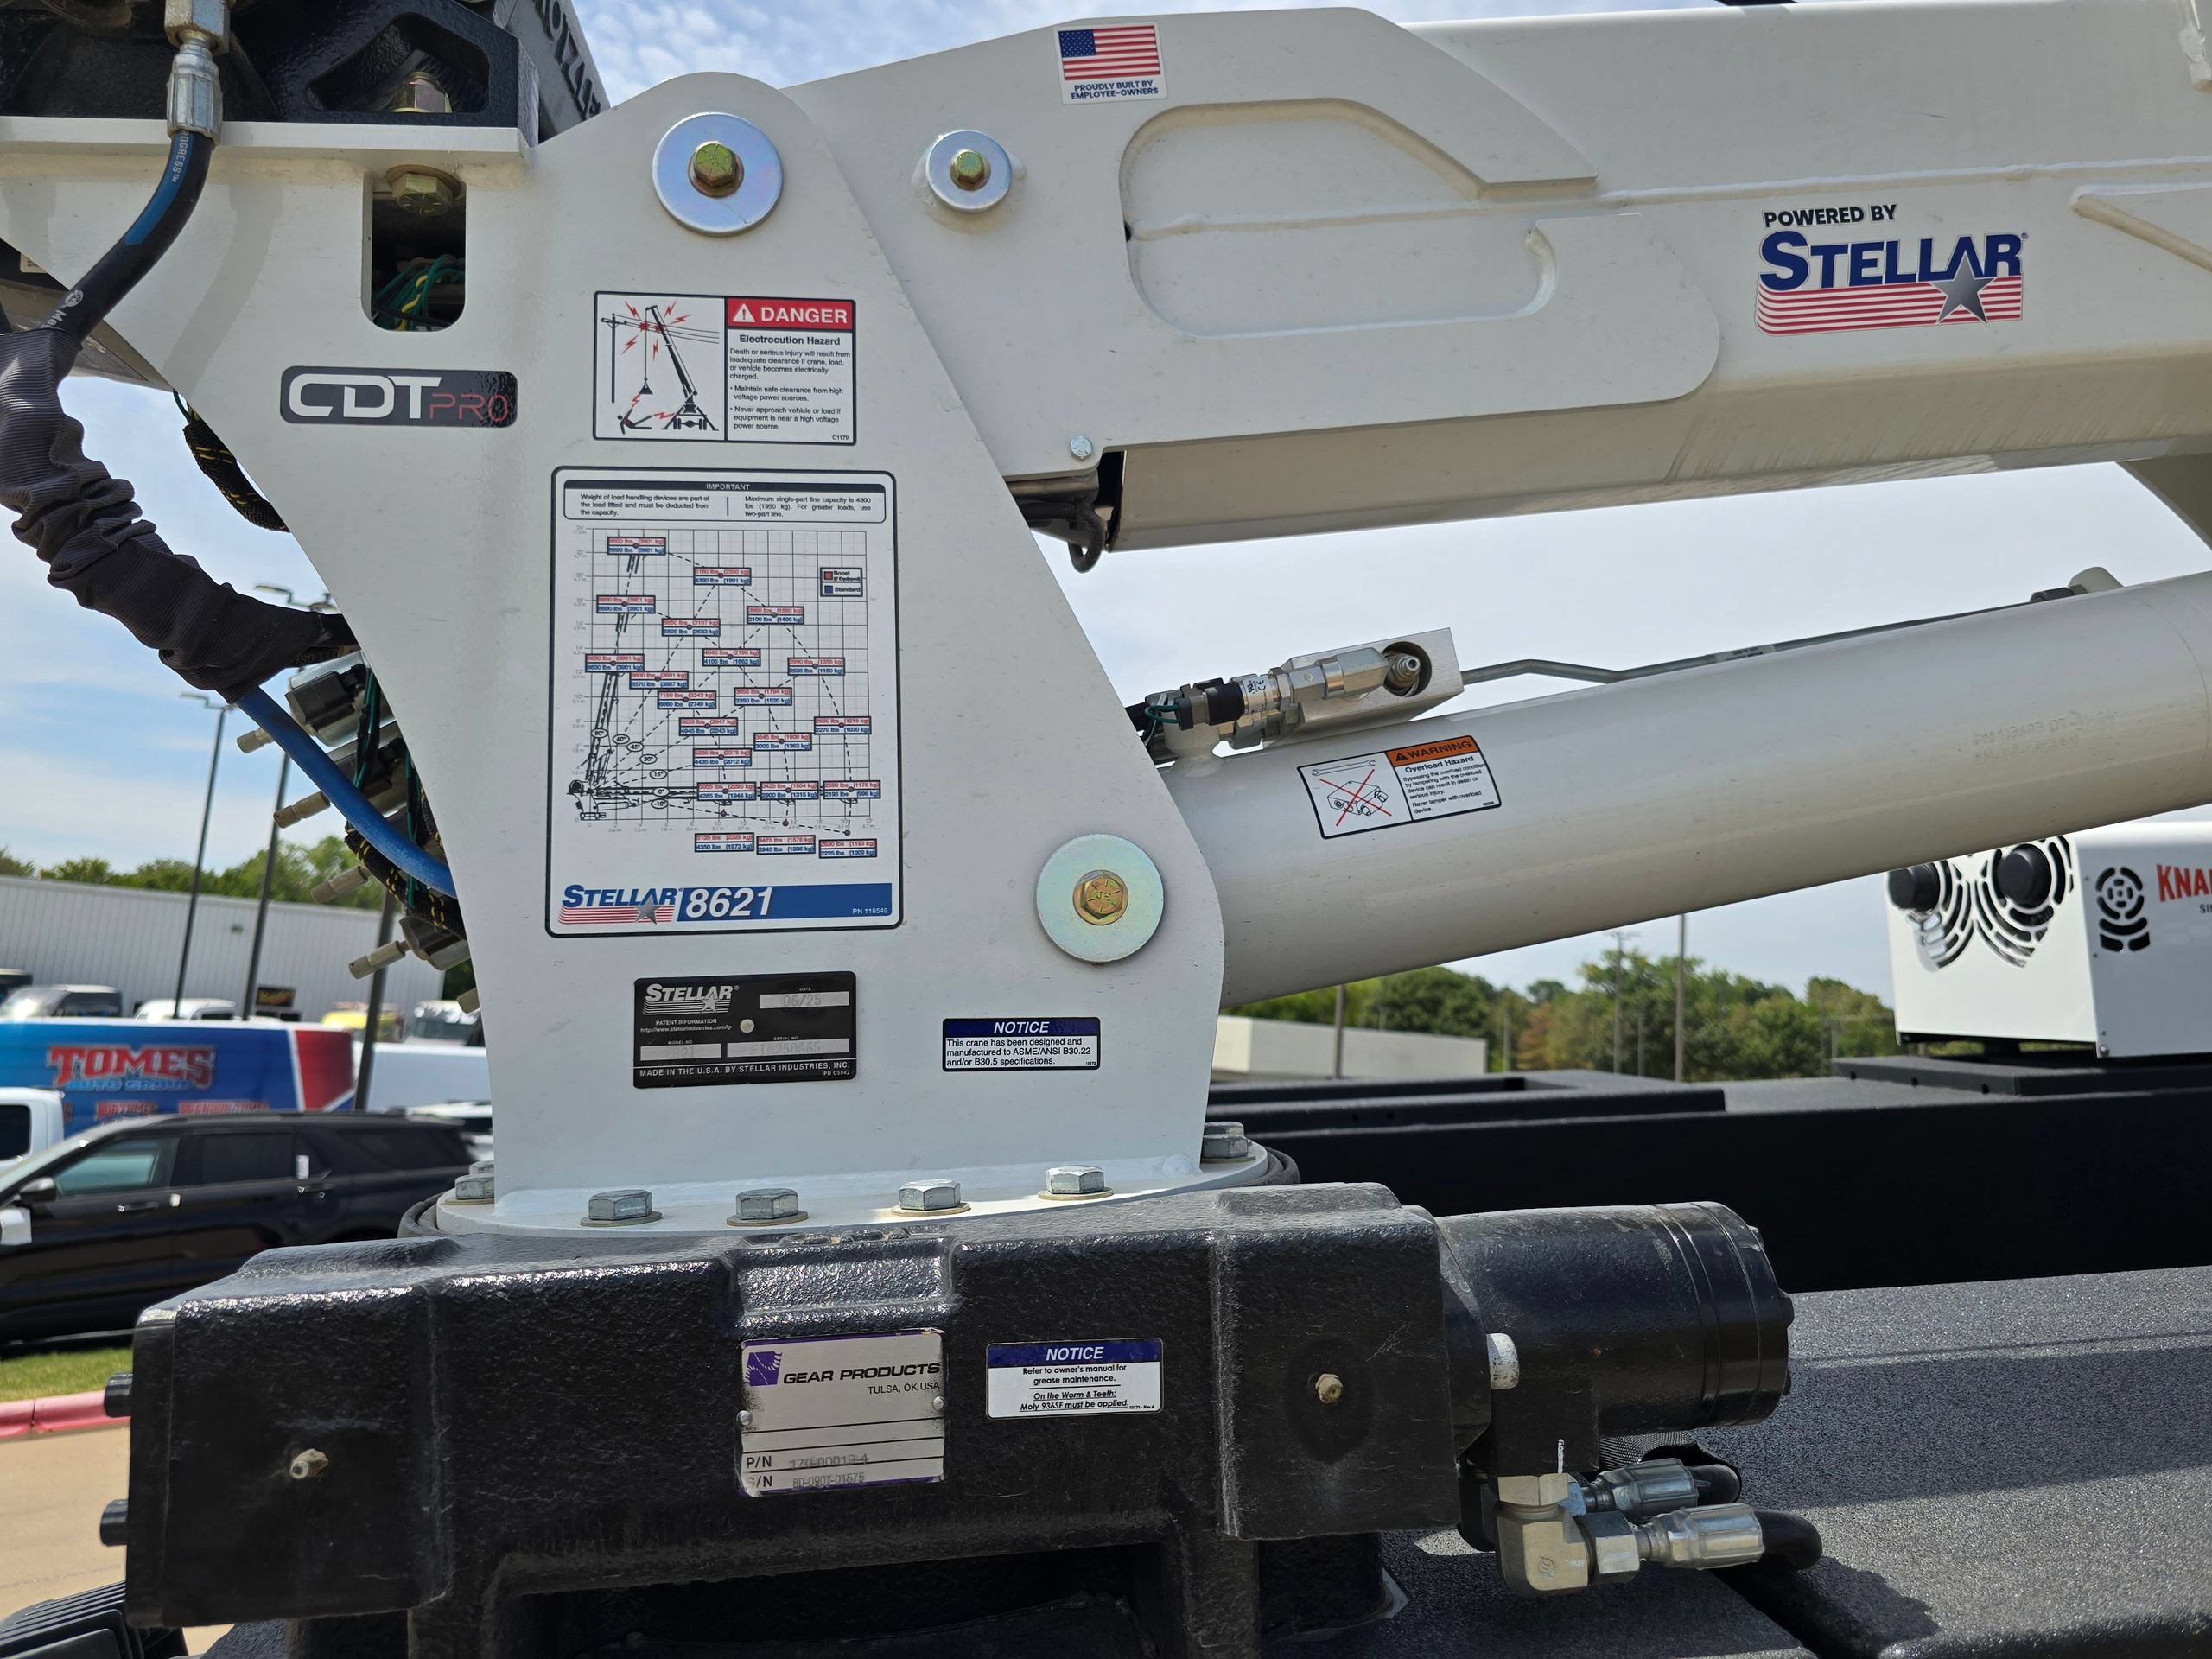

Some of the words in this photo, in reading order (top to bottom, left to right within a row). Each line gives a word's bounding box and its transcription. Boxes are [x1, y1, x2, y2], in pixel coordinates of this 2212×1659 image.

[1071, 87, 1159, 99] EMPLOYEE-OWNERS
[1074, 82, 1114, 92] PROUDLY
[1764, 207, 1864, 227] POWERED
[1871, 204, 1897, 221] BY
[761, 307, 848, 324] DANGER
[739, 334, 804, 344] Electrocution
[806, 336, 840, 345] Hazard
[289, 373, 442, 419] CDT
[429, 392, 509, 423] PRO
[1408, 741, 1471, 758] WARNING
[1405, 761, 1443, 772] Overload
[1444, 755, 1474, 766] Hazard
[685, 887, 774, 918] 8621
[645, 983, 734, 1002] STELLAR
[994, 1021, 1050, 1033] NOTICE
[1029, 1038, 1065, 1046] designed
[48, 1045, 214, 1089] TOMES
[779, 1062, 830, 1071] INDUSTRIES,
[1000, 1057, 1054, 1065] specifications.
[1046, 1346, 1104, 1361] NOTICE
[784, 1370, 833, 1384] GEAR
[840, 1363, 941, 1381] PRODUCTS
[1062, 1375, 1116, 1383] maintenance.
[868, 1384, 900, 1395] TULSA,
[904, 1382, 918, 1392] OK
[920, 1381, 940, 1390] USA
[1020, 1402, 1039, 1411] Moly
[746, 1456, 772, 1469] P/N
